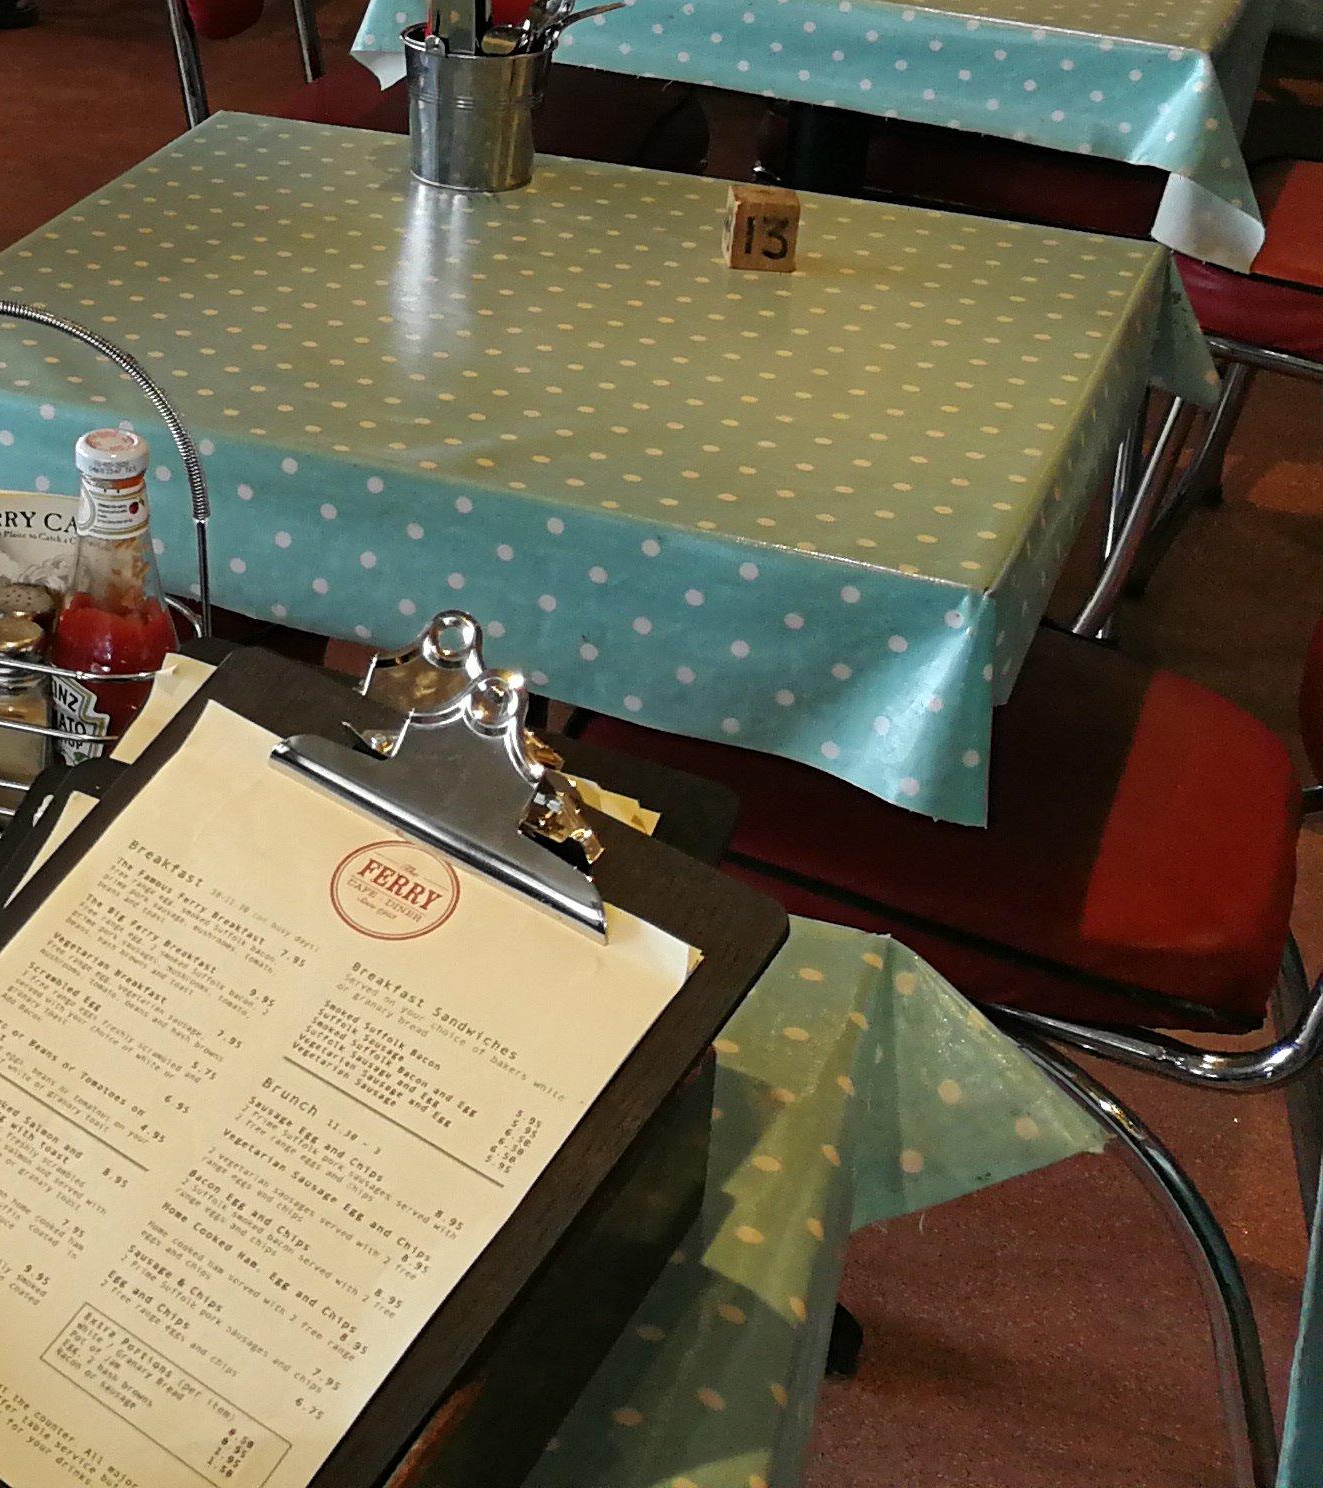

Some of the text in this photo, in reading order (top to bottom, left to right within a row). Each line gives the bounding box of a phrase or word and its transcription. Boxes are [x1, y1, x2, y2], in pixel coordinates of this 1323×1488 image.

[741, 215, 789, 260] 13
[44, 512, 78, 534] CA
[127, 839, 205, 887] Breakfast
[356, 858, 443, 911] FERRY
[115, 857, 306, 968] The Famous Ferry Breakfast 7.95
[52, 931, 110, 970] Vegetarian
[112, 968, 167, 1004] Breakfast
[84, 893, 276, 1008] The Big Ferry Breakfast 9.95
[26, 961, 218, 1080] Scrambled Egg 5.75
[317, 1007, 360, 1035] Suffolk
[362, 1033, 405, 1062] Sausage
[323, 999, 361, 1024] Smoked
[363, 1022, 407, 1050] Suffolk
[409, 1048, 441, 1071] Bacon
[350, 961, 518, 1061] Breakfast Sandwiches
[261, 1076, 320, 1117] Brunch
[291, 1041, 351, 1079] Vegetarian
[353, 1077, 397, 1107] Sausage
[297, 1032, 357, 1071] Vegetarian
[360, 1069, 404, 1099] Sausage
[407, 1098, 428, 1113] and
[430, 1111, 451, 1129] Egg
[304, 1024, 347, 1053] Suffolk
[349, 1051, 392, 1080] Sausage
[395, 1079, 417, 1094] and
[419, 1092, 439, 1109] Egg
[310, 1016, 349, 1041] Smoked
[350, 1039, 395, 1068] Suffolk
[397, 1066, 429, 1089] Bacon
[432, 1088, 454, 1103] and
[456, 1101, 477, 1118] Egg
[22, 1115, 59, 1143] Salmon
[62, 1143, 84, 1158] and
[162, 1093, 191, 1114] 6.95
[247, 1096, 293, 1128] Sausage
[297, 1126, 319, 1144] Egg
[322, 1143, 345, 1159] and
[348, 1157, 383, 1182] Chips
[9, 1122, 36, 1141] with
[37, 1139, 70, 1163] toast
[221, 1128, 431, 1262] Vegetarian Sausage Egg and Chips
[22, 1263, 51, 1286] 9.95
[161, 1202, 357, 1333] Home Cooked Ham, Egg and Chips
[188, 1169, 403, 1309] Bacon Egg and Chips 8.95
[107, 1270, 325, 1421] Egg and Chips 6.75
[127, 1244, 342, 1391] Sausage & Chips 7.95
[338, 1332, 368, 1355] 8.95
